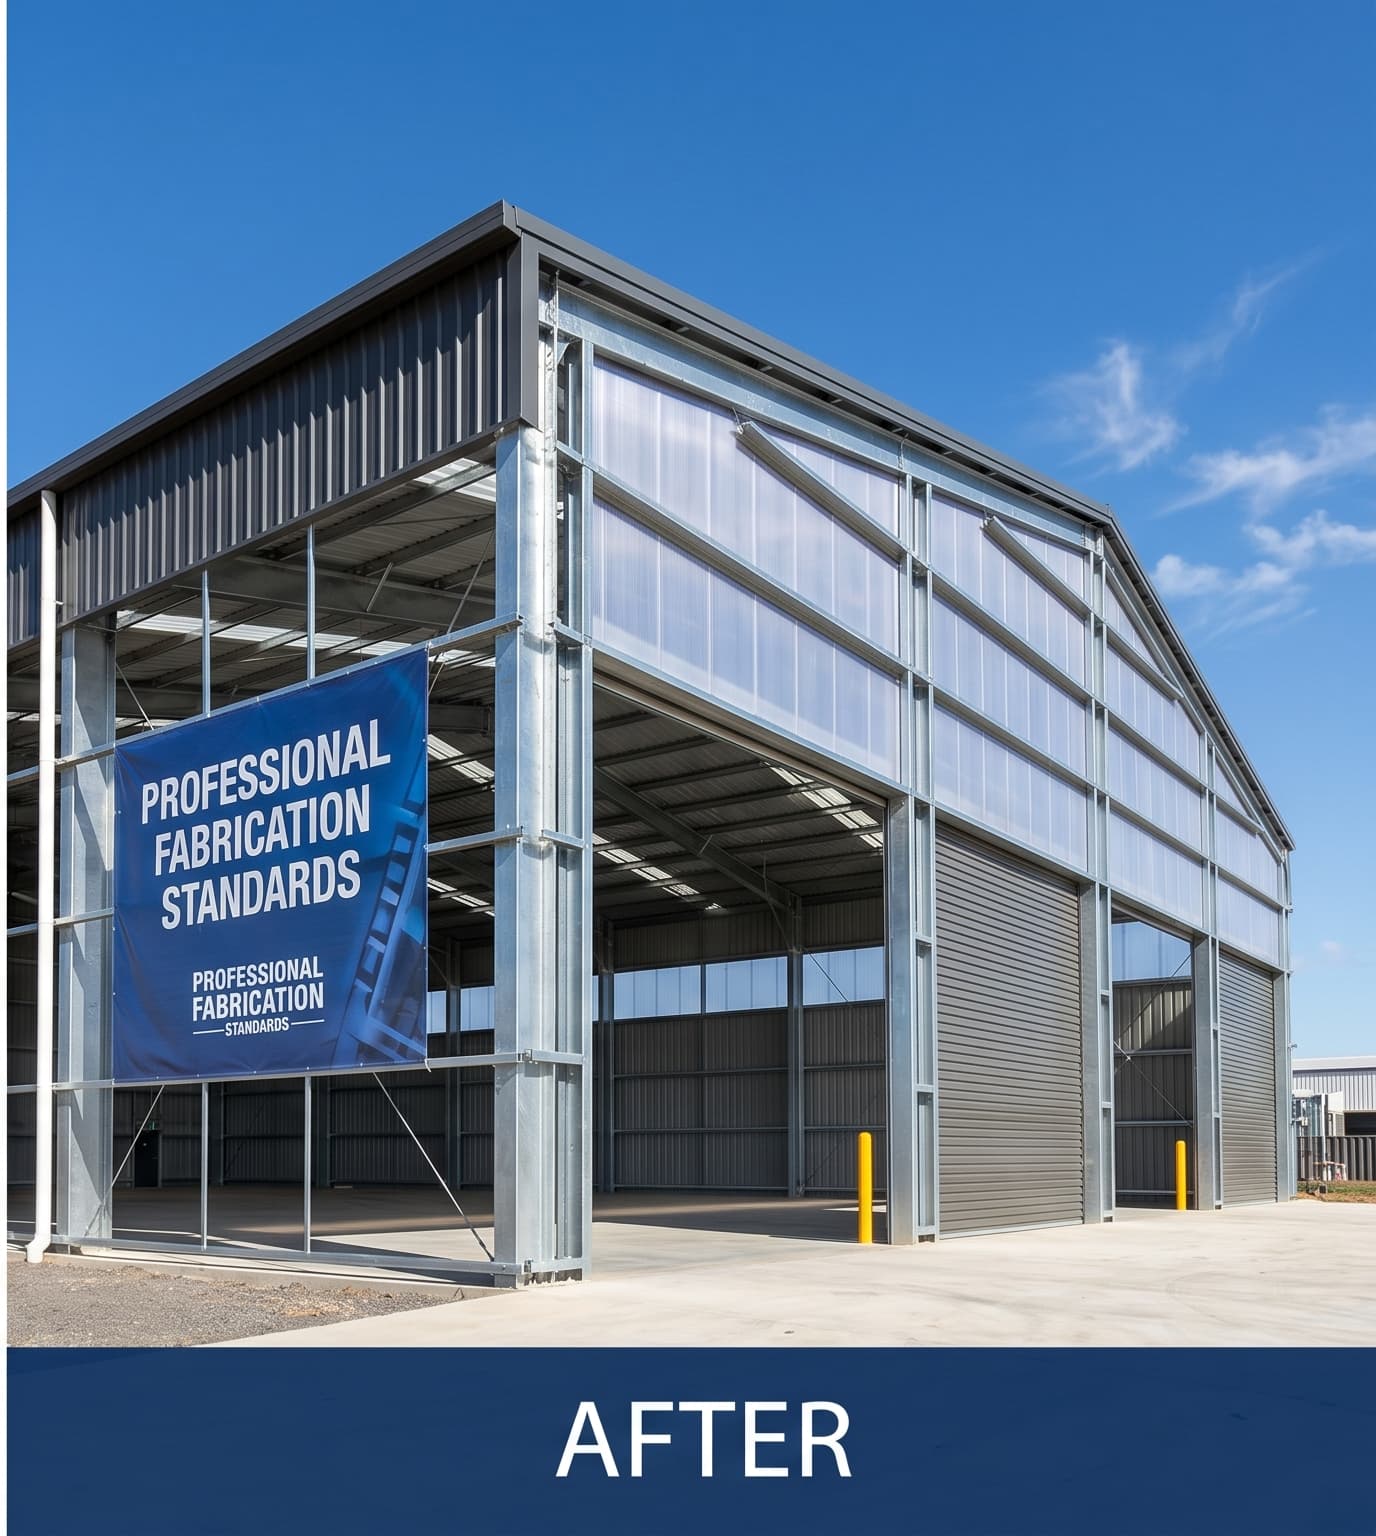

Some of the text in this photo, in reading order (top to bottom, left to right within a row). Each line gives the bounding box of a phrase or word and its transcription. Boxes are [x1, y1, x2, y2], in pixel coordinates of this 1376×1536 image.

[142, 719, 391, 825] PROFESSIONAL
[155, 784, 370, 876] FABRICATION
[161, 850, 361, 930] STANDARDS
[192, 956, 324, 993] PROFESSIONAL
[192, 982, 324, 1022] FABRICATION
[225, 1017, 290, 1037] STANDARDS
